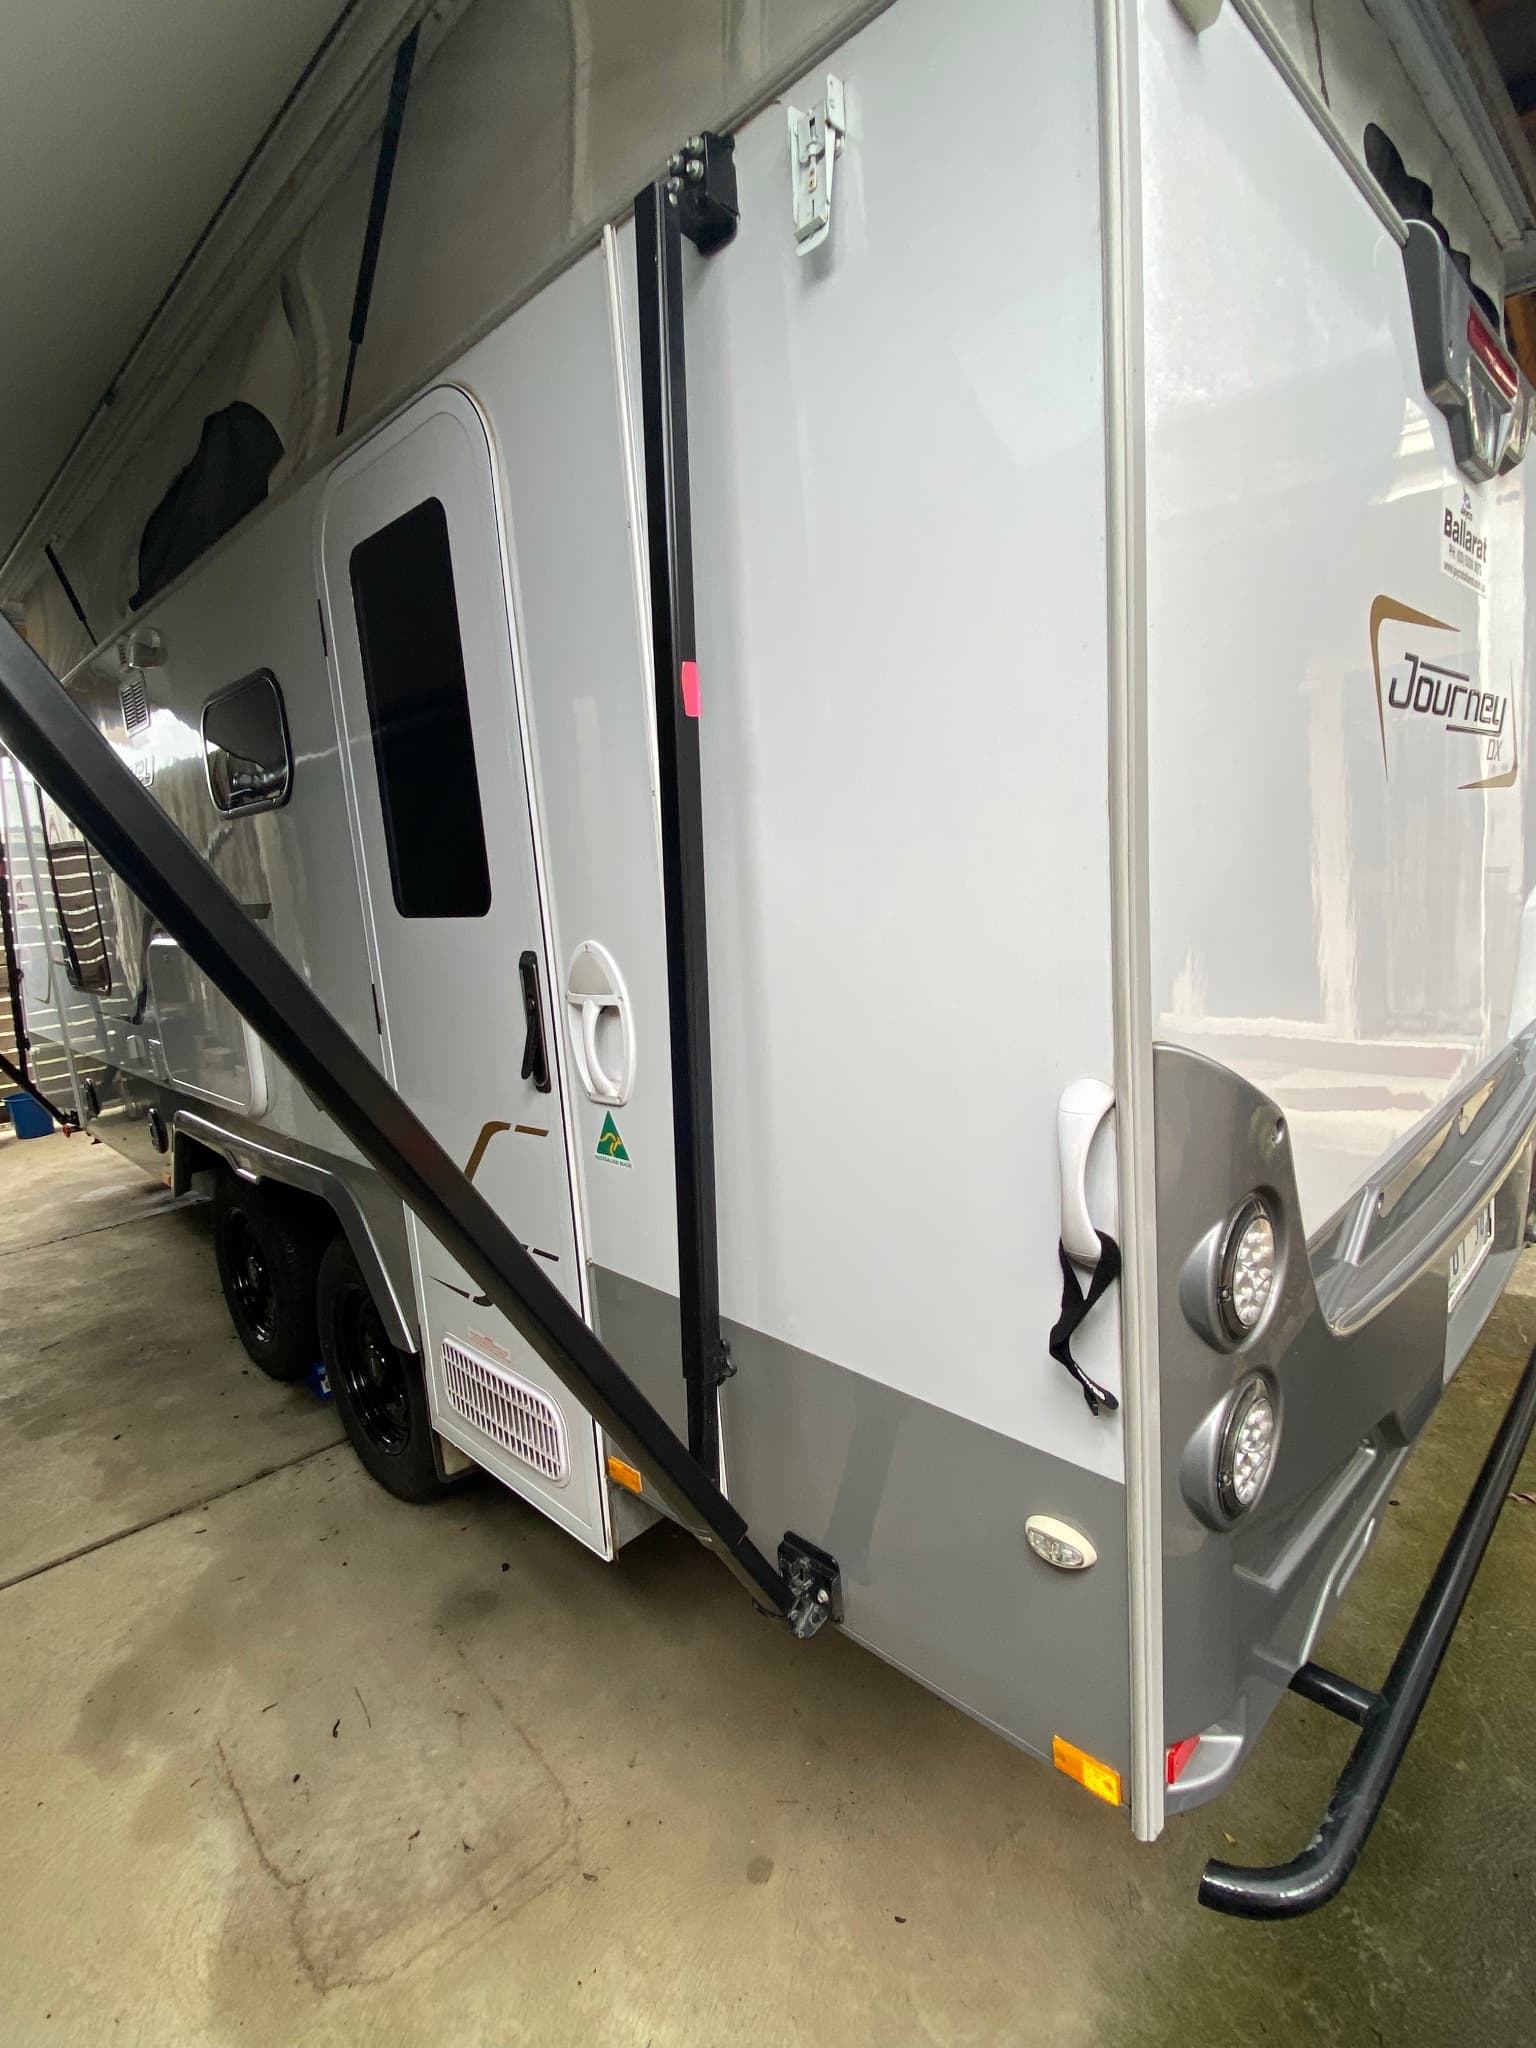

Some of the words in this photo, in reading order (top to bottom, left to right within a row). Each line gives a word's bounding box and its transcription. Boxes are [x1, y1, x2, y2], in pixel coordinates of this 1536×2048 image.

[1443, 507, 1487, 563] Ballarat
[1388, 651, 1508, 738] Journey
[1486, 738, 1503, 761] DX
